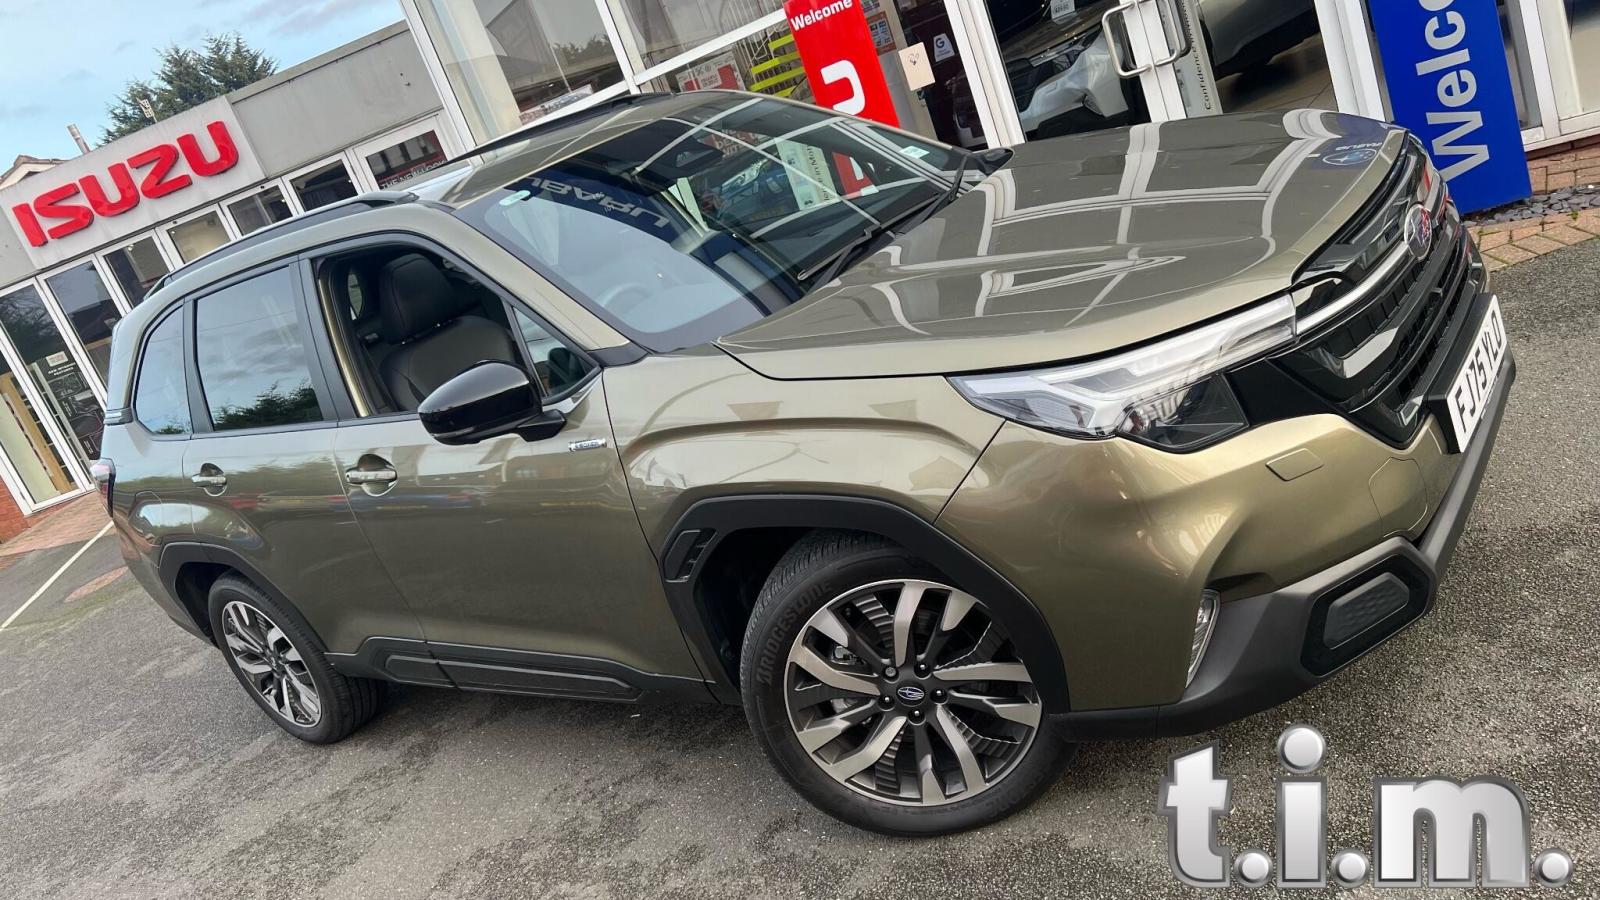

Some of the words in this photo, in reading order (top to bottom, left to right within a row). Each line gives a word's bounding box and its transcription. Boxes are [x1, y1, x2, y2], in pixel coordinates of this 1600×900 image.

[791, 0, 853, 31] Welcome
[12, 121, 239, 247] ISUZU
[1454, 346, 1487, 434] FJ75
[757, 582, 832, 687] BRIDGESTONE
